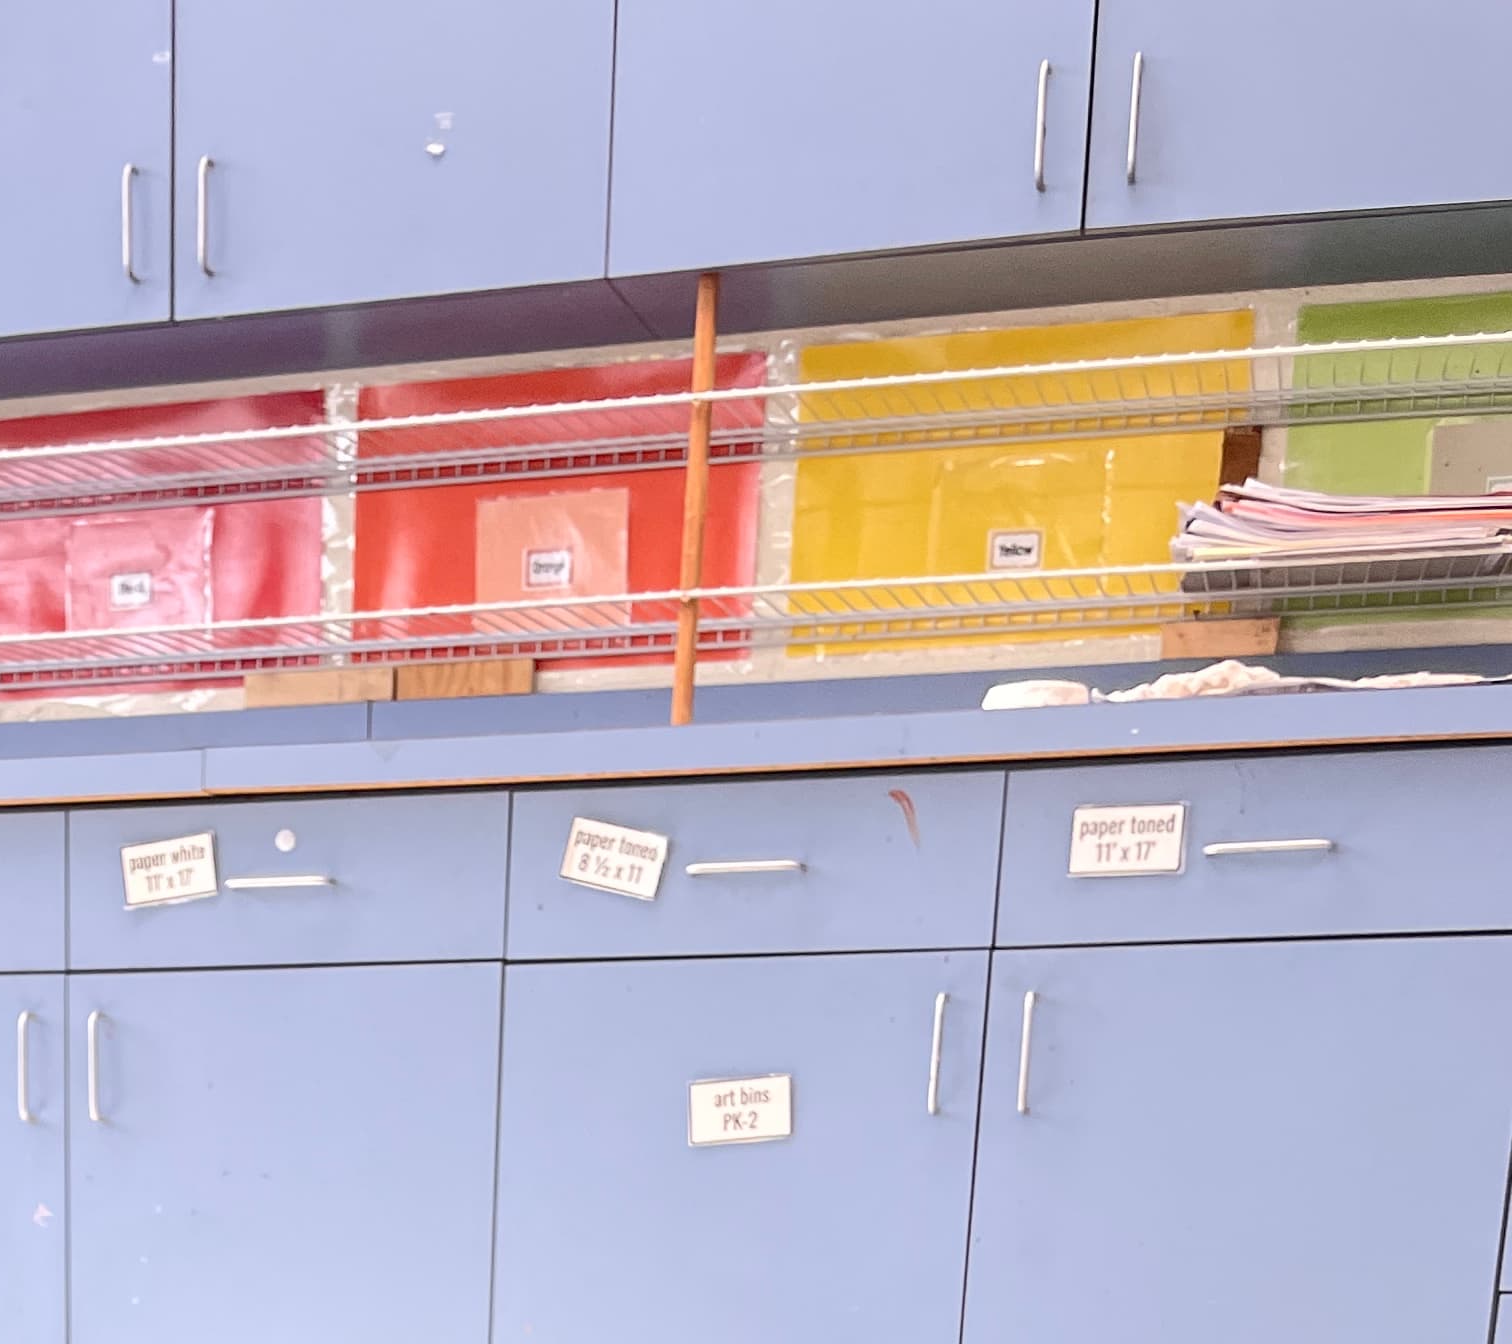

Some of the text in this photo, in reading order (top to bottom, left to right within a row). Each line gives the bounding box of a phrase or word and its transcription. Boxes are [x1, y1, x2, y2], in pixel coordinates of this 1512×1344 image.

[1079, 812, 1177, 841] paper toned
[129, 844, 206, 874] paper white
[574, 829, 659, 862] paper toned
[1120, 846, 1131, 862] x
[578, 853, 590, 872] 8
[614, 866, 624, 880] x
[714, 1087, 771, 1108] art bins
[723, 1110, 758, 1131] PK-2
